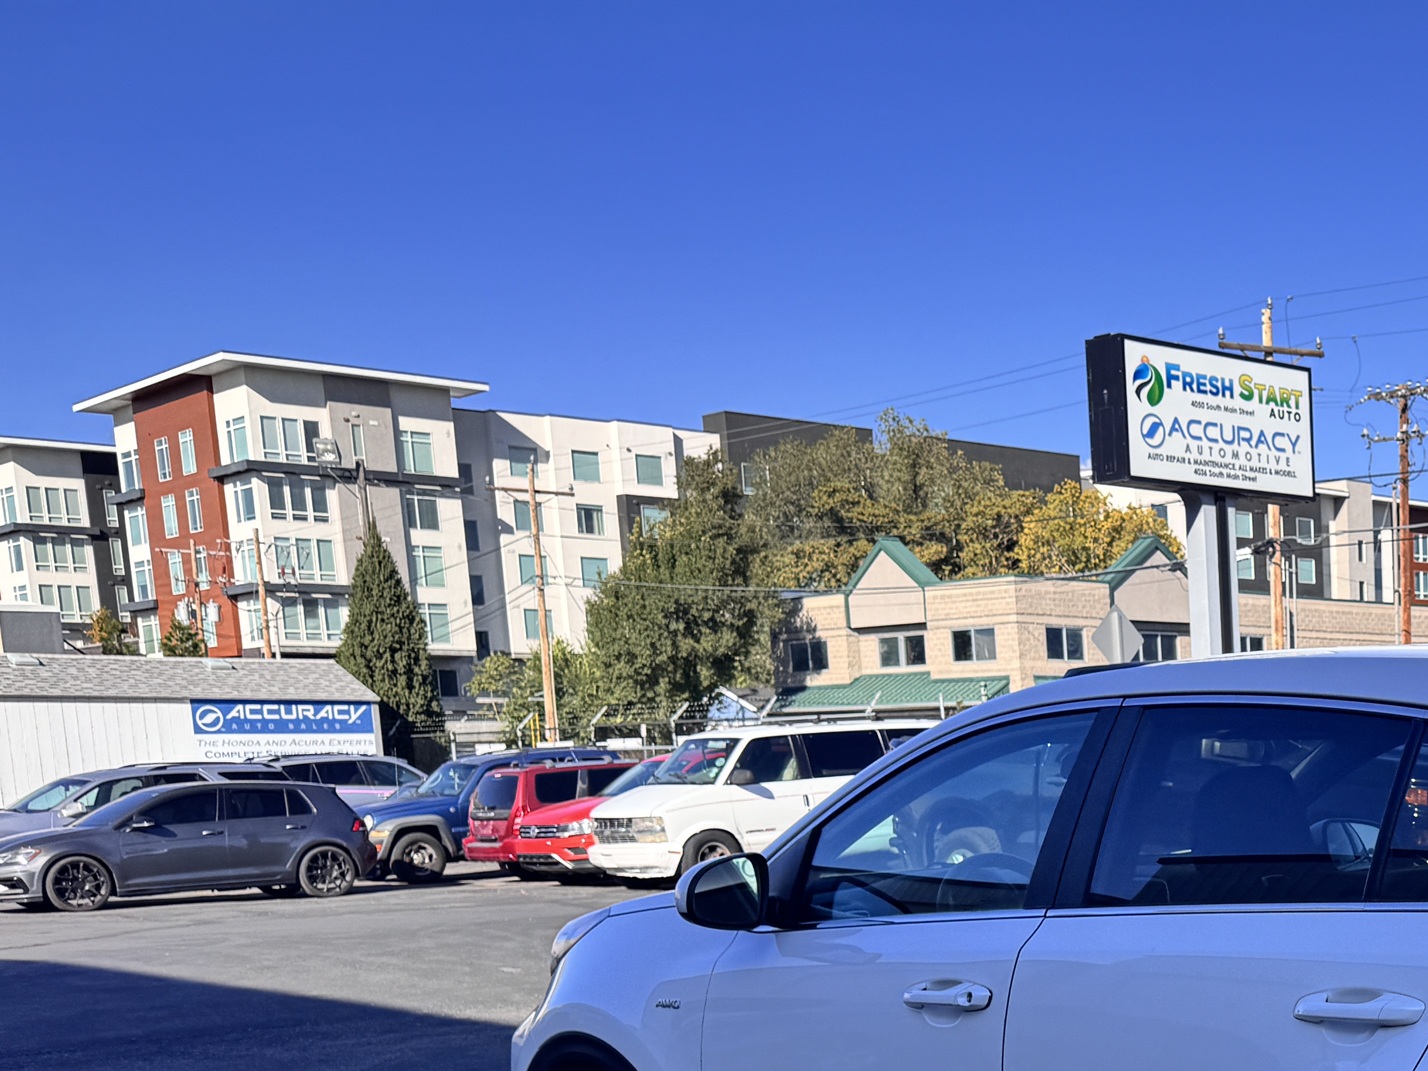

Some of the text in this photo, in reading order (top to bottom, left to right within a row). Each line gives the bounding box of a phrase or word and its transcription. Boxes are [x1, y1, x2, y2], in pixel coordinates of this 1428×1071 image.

[1165, 362, 1303, 410] FRESH START
[1206, 402, 1222, 413] South
[1223, 403, 1238, 414] Main
[1238, 405, 1255, 417] Street
[1269, 408, 1302, 423] AUTO
[1167, 416, 1301, 455] ACCURACY
[1147, 452, 1165, 462] AUTO
[1166, 454, 1186, 465] REPAIR
[1238, 464, 1248, 473] ALL
[1249, 465, 1268, 475] MAKES
[1185, 443, 1291, 467] AUTOMOTIVE
[1208, 469, 1225, 479] South
[1225, 471, 1241, 482] Main
[1241, 474, 1258, 484] Street
[226, 703, 368, 725] ACCURACY
[231, 722, 341, 731] AUTO SALES
[197, 738, 374, 748] THE HONDA AND ACURA EXPERTS
